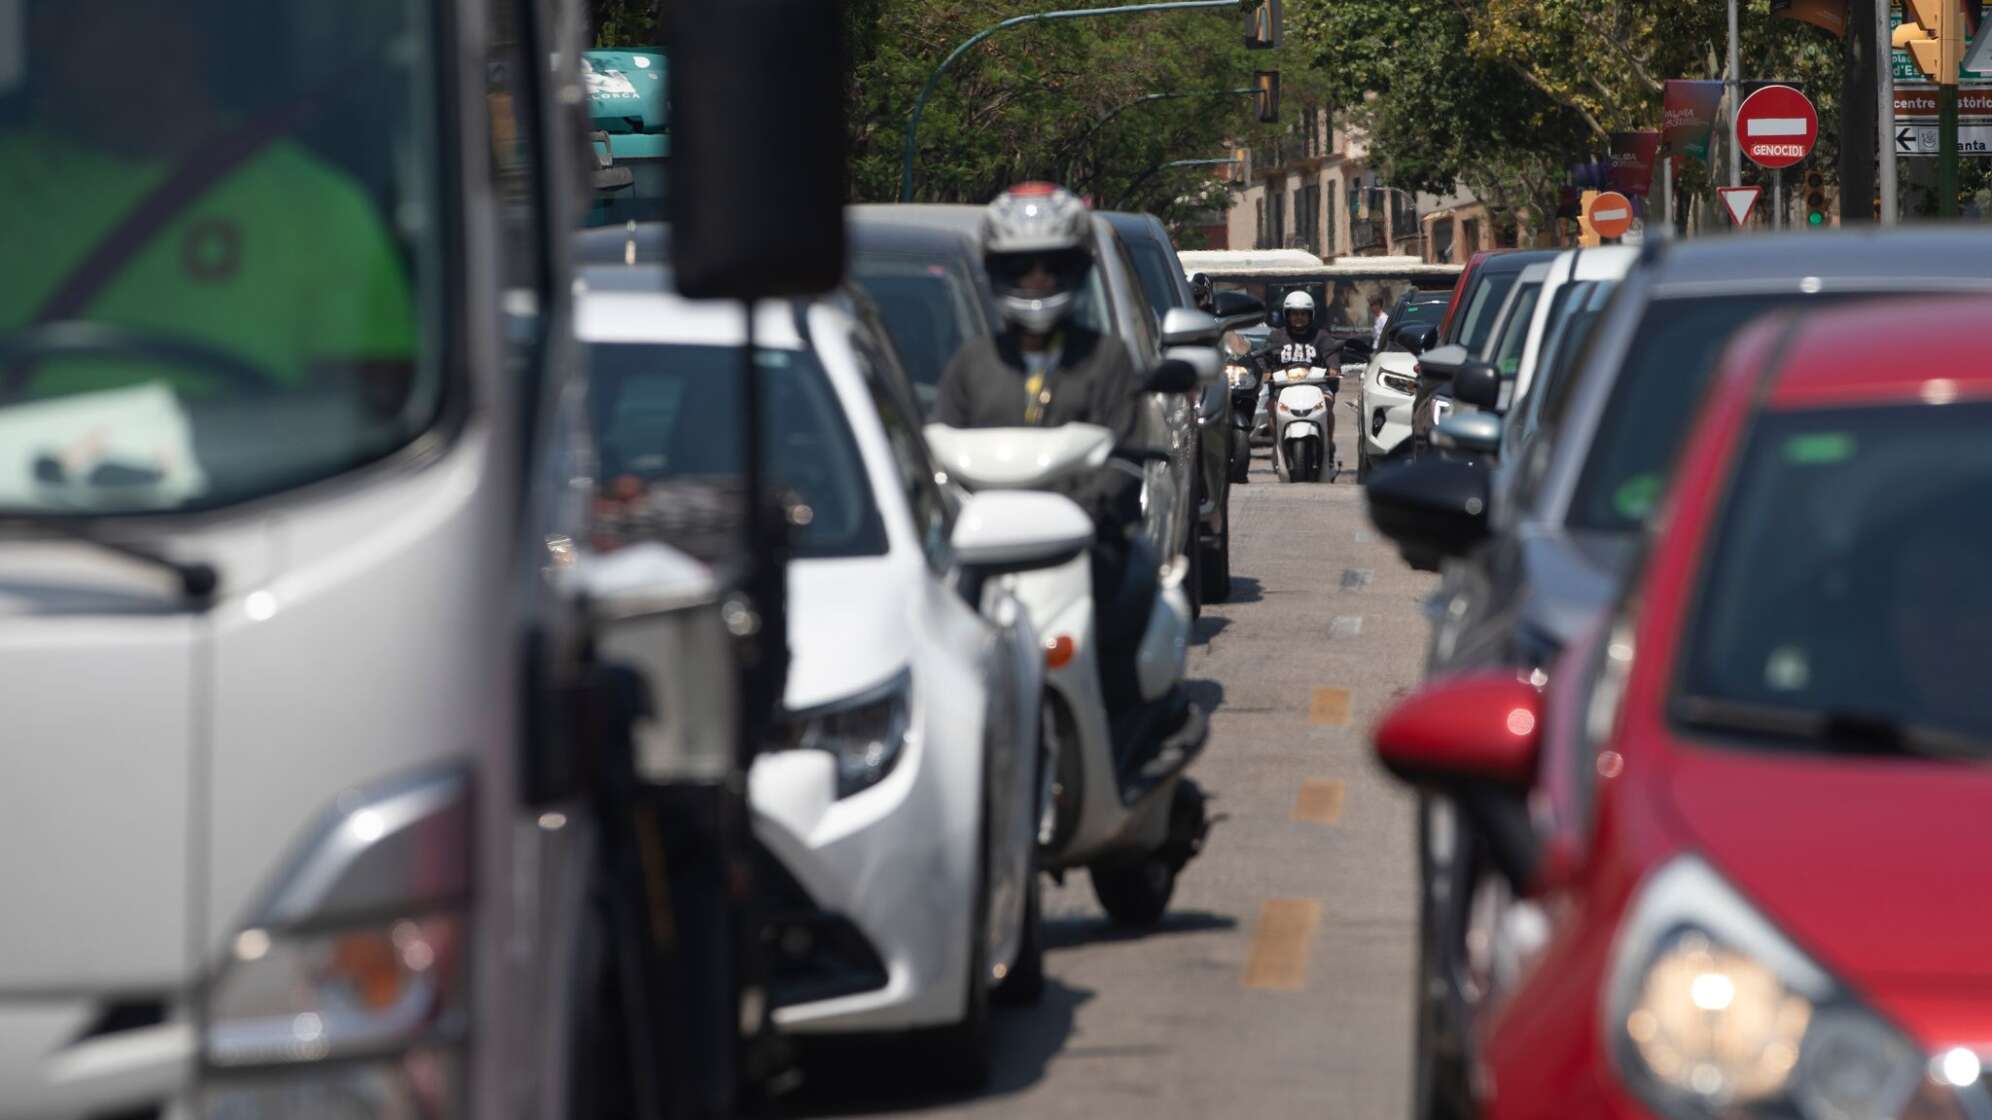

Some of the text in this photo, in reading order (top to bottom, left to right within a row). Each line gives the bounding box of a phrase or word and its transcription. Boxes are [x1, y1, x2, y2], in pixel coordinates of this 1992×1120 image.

[1894, 96, 1992, 109] centre stòric
[1753, 145, 1803, 157] GENOCIDI
[1956, 140, 1986, 151] anta
[1281, 343, 1317, 363] GAP
